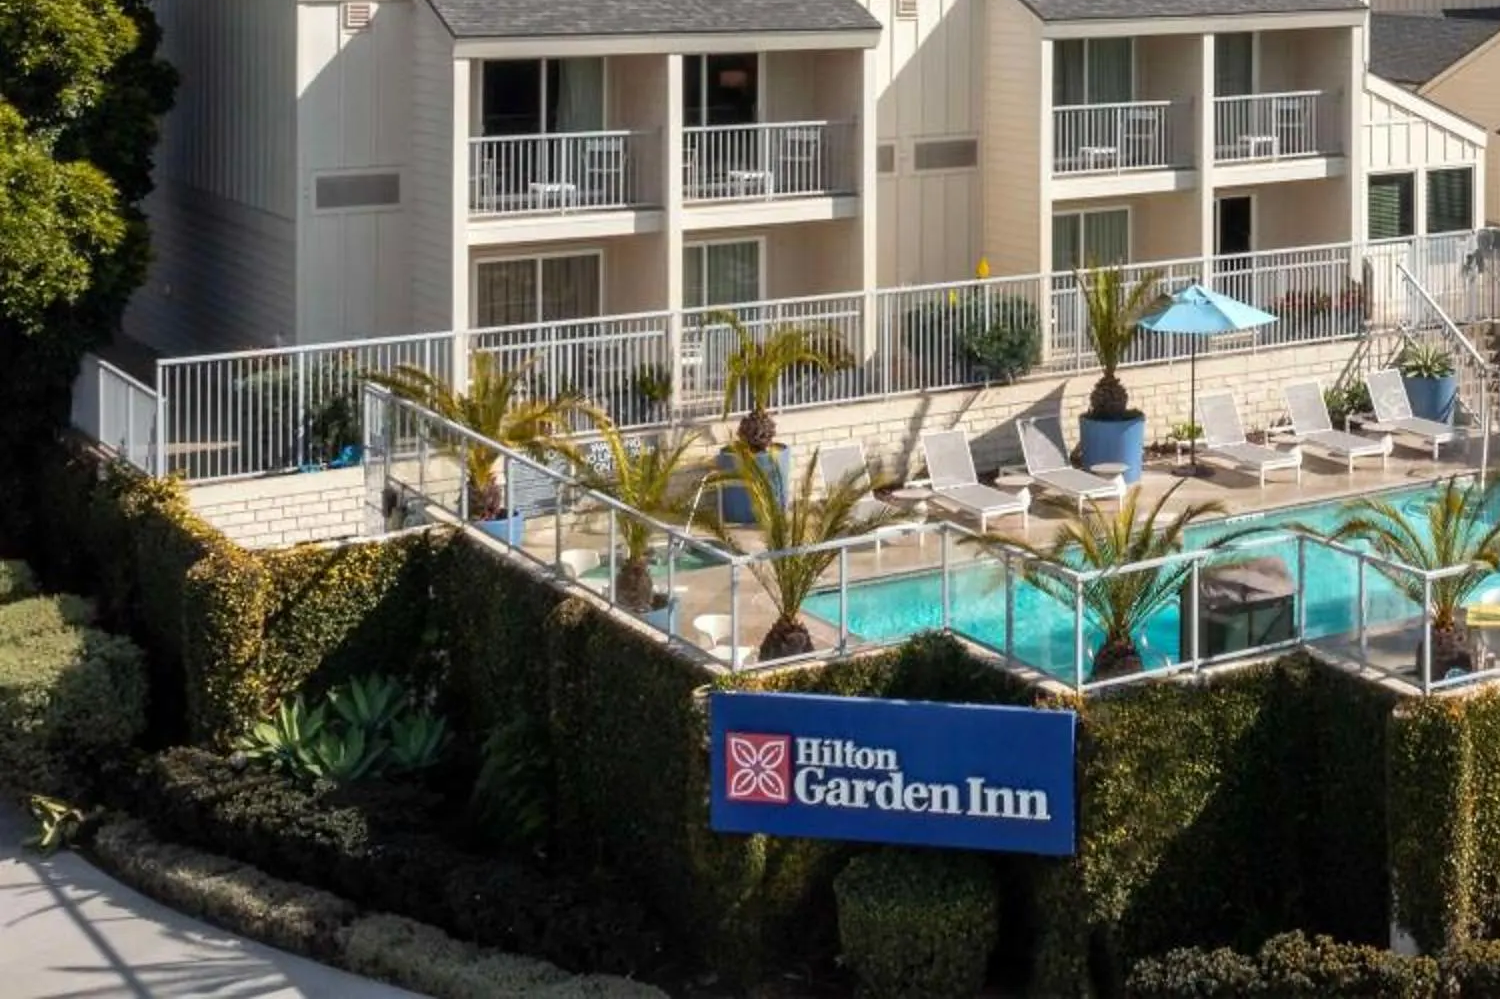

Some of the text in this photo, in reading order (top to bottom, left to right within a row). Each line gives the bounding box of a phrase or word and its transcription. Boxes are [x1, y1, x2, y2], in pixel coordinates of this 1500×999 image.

[795, 737, 899, 770] Hilton
[794, 767, 1051, 821] Garden Inn
